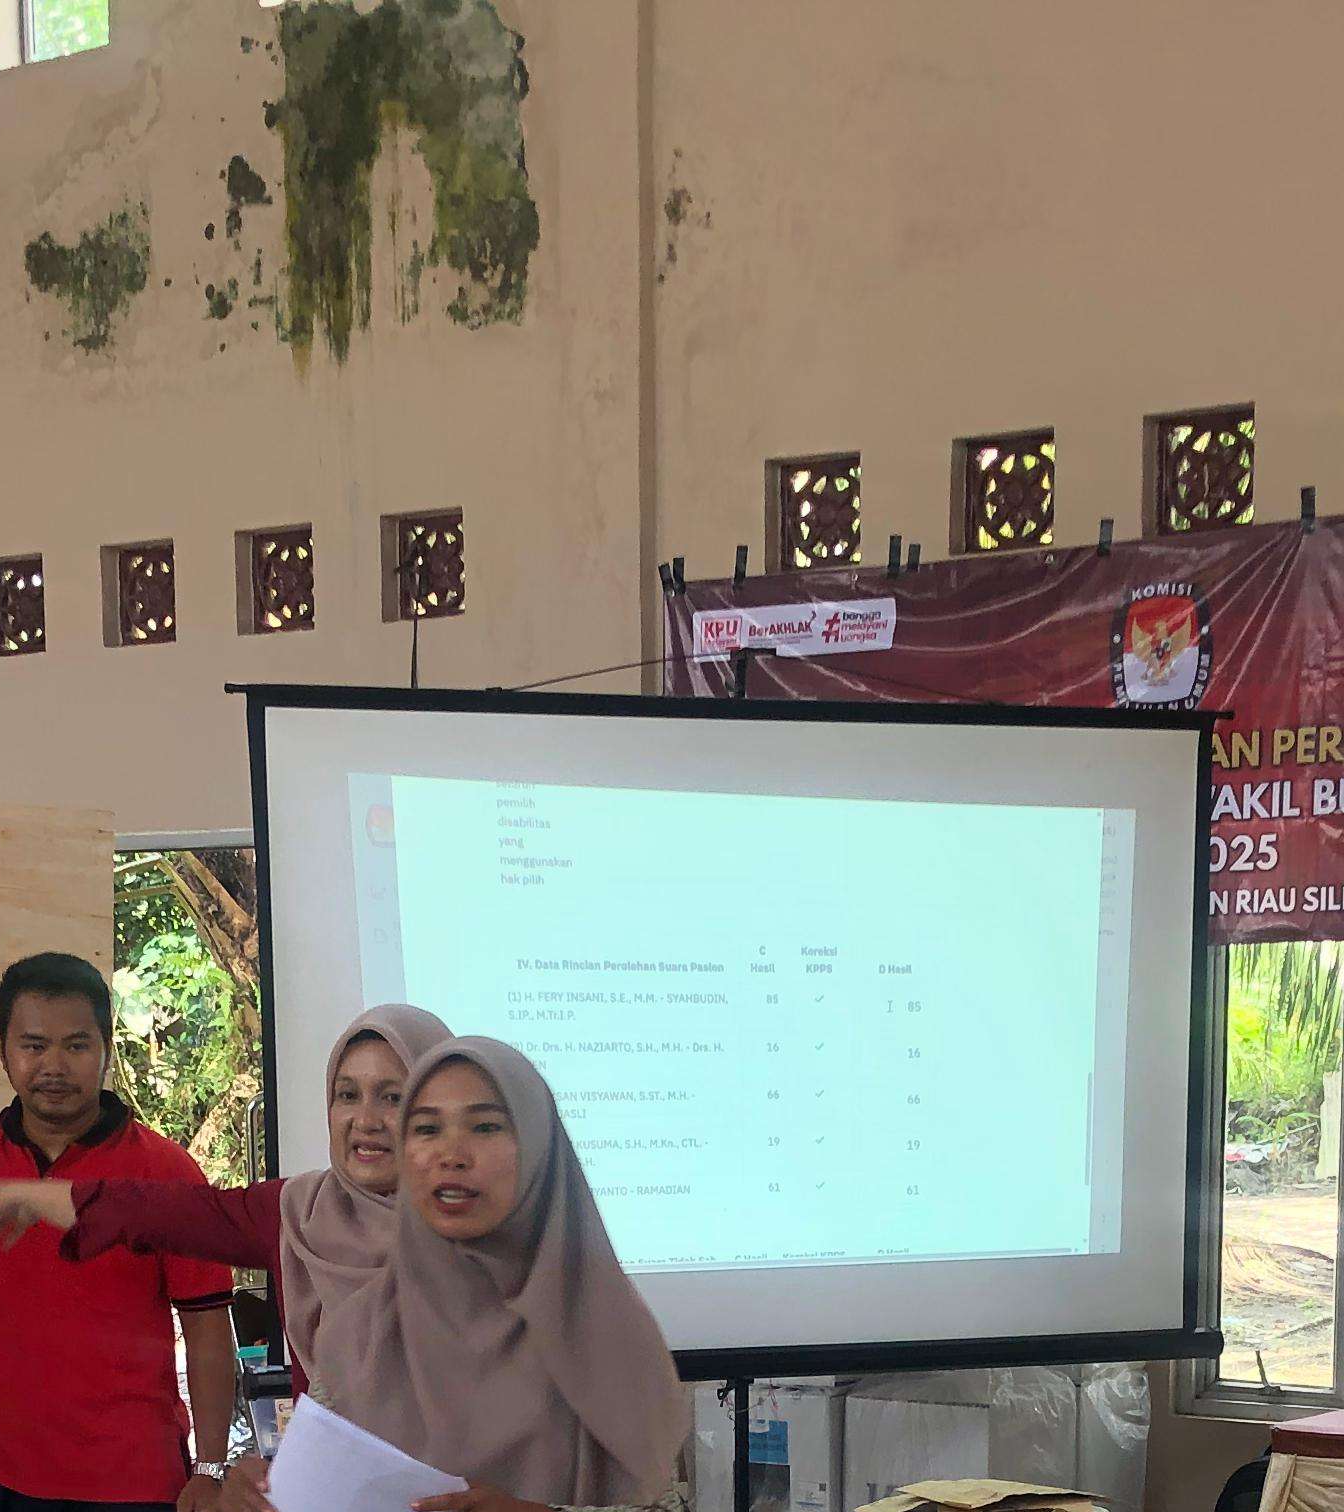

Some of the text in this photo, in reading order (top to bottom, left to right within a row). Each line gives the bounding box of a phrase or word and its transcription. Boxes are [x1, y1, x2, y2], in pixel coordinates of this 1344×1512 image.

[1131, 582, 1193, 600] KOMISI
[703, 619, 739, 639] KPU
[748, 621, 812, 637] BerAKHLAK
[496, 796, 536, 809] pemilih
[1210, 779, 1301, 821] AKIL
[496, 816, 551, 830] disabilitas
[498, 836, 525, 849] yang
[499, 856, 574, 870] menggunakan
[500, 873, 545, 888] hak pilih
[1235, 887, 1296, 914] RIAU
[800, 945, 838, 957] Koreksi
[535, 959, 560, 971] Data
[561, 959, 601, 972] Rincian
[603, 960, 656, 974] Perolehan
[658, 961, 689, 974] Suara
[690, 961, 725, 974] Paslon
[750, 962, 776, 974] Hasil
[805, 963, 833, 975] KPPS
[887, 963, 913, 975] Hasil
[507, 991, 523, 1004] (1)
[524, 992, 536, 1003] H.
[537, 992, 565, 1003] FERY
[566, 992, 607, 1005] INSANI,
[633, 993, 659, 1004] M.M.
[765, 993, 780, 1005] 85
[907, 1001, 922, 1013] 85
[526, 1041, 542, 1053] Dr.
[564, 1041, 577, 1053] H.
[578, 1041, 634, 1054] NAZIARTO,
[661, 1042, 684, 1054] M.H.
[692, 1042, 712, 1054] Drs.
[713, 1042, 726, 1054] H.
[765, 1041, 780, 1053] 16
[907, 1047, 921, 1059] 16
[580, 1090, 637, 1103] VISYAWAN,
[667, 1090, 690, 1102] M.H.
[766, 1089, 780, 1101] 66
[907, 1094, 921, 1106] 66
[576, 1139, 622, 1151] KUSUMA,
[681, 1138, 703, 1149] CTL.
[767, 1135, 780, 1147] 19
[906, 1139, 920, 1151] 19
[636, 1185, 692, 1196] RAMADIAN
[767, 1181, 780, 1193] 61
[906, 1185, 920, 1197] 61
